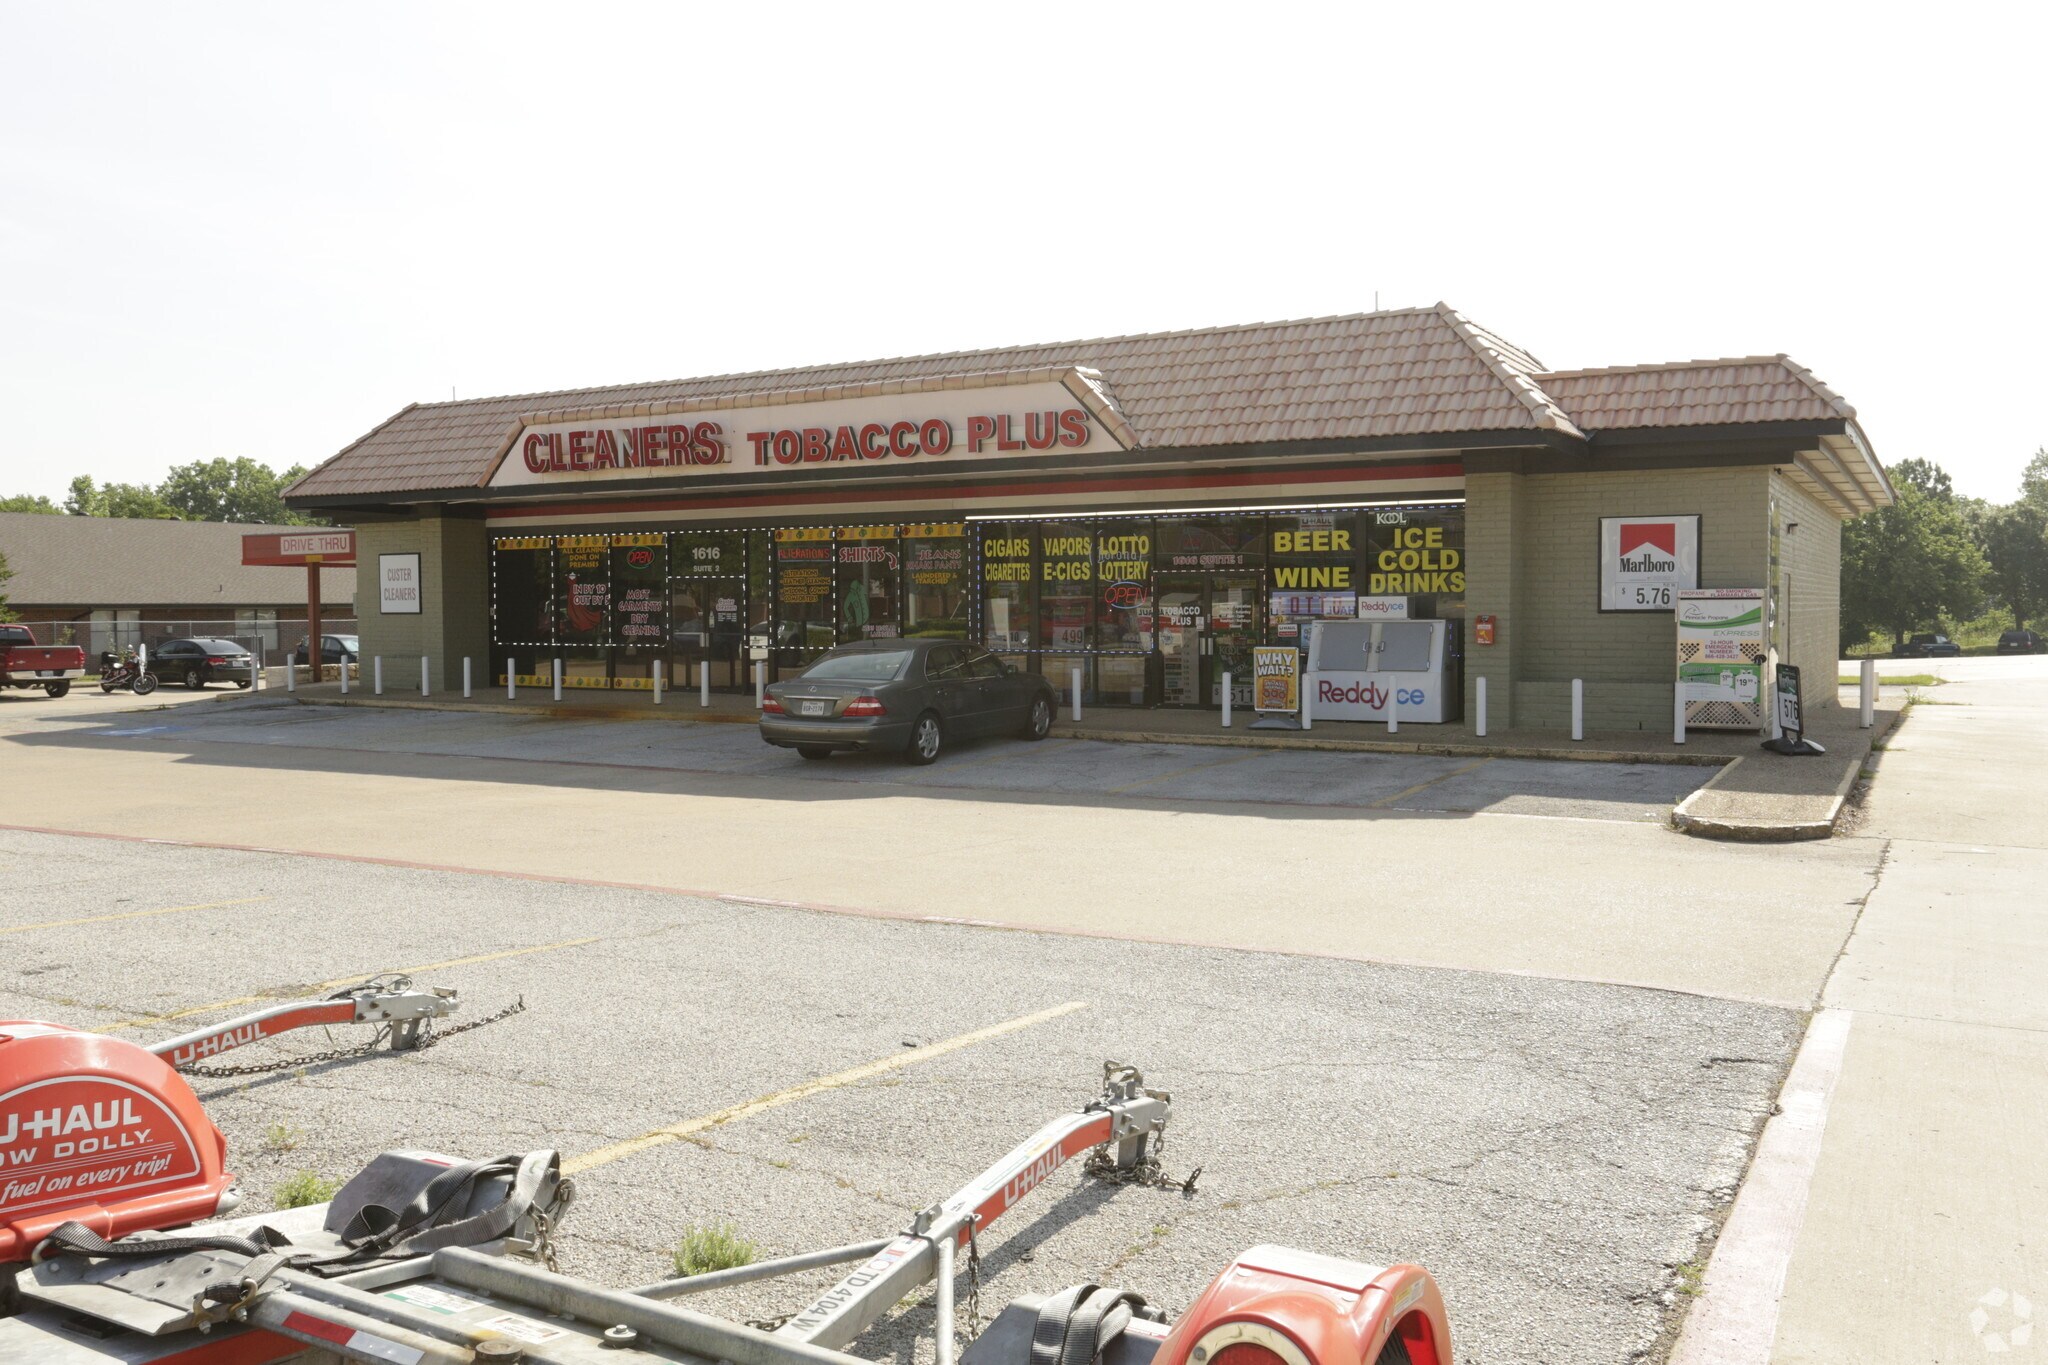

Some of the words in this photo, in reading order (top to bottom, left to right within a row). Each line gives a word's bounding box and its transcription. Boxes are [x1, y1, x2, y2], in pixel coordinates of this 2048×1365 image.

[523, 421, 725, 473] CLEANERS
[747, 418, 952, 466] TOBACCO
[967, 409, 1090, 453] PLUS
[1376, 512, 1407, 525] KOOL
[283, 538, 314, 552] DRIVE
[318, 537, 347, 550] THRU
[1043, 537, 1091, 556] VAPORS
[1099, 535, 1149, 556] LOTTO
[1274, 530, 1351, 552] BEER
[1394, 527, 1443, 549] ICE
[575, 546, 607, 554] CLEANING
[692, 546, 721, 560] 1616
[778, 548, 830, 559] ALTERATIONS
[839, 546, 885, 563] SHIRTS
[919, 549, 961, 560] JEANS
[984, 538, 1030, 558] CIGARS
[627, 551, 653, 564] OPEN
[1199, 554, 1236, 565] SUITE
[1236, 554, 1243, 564] 1
[1378, 549, 1460, 571] COLD
[1619, 553, 1675, 573] Marlboro
[387, 568, 412, 581] CUSTER
[693, 564, 712, 572] SUITE
[714, 564, 720, 572] 2
[985, 562, 1030, 581] CIGARETTES
[1043, 561, 1091, 581] E-CIGS
[1099, 561, 1148, 580] LOTTERY
[1273, 566, 1350, 588] WINE
[1370, 571, 1465, 594] DRINKS
[383, 587, 416, 601] CLEANERS
[573, 584, 583, 595] IN
[583, 584, 595, 594] BY
[595, 584, 606, 594] 10
[626, 589, 651, 600] MOST
[1104, 587, 1147, 604] OPEN
[1621, 587, 1626, 595] $
[1636, 587, 1670, 605] 5.76
[573, 595, 592, 606] OUT
[592, 595, 603, 605] BY
[618, 600, 662, 612] GARMENTS
[630, 613, 649, 624] DRY
[1162, 606, 1200, 616] TOBACCO
[1170, 616, 1192, 625] PLUS
[622, 625, 660, 636] CLEANING
[1257, 652, 1294, 666] WHY
[1257, 665, 1294, 677] WAIT?
[173, 1022, 267, 1065] U-HAUL
[0, 1097, 142, 1145] U-HAUL
[54, 1128, 152, 1158] DOLLY
[0, 1176, 46, 1205] fuel
[46, 1176, 73, 1192] on
[75, 1164, 132, 1187] every
[133, 1153, 173, 1177] trip!
[1004, 1143, 1066, 1208] U-HAUL
[847, 1271, 880, 1288] TD
[808, 1287, 853, 1316] 4104
[790, 1317, 820, 1332] W
